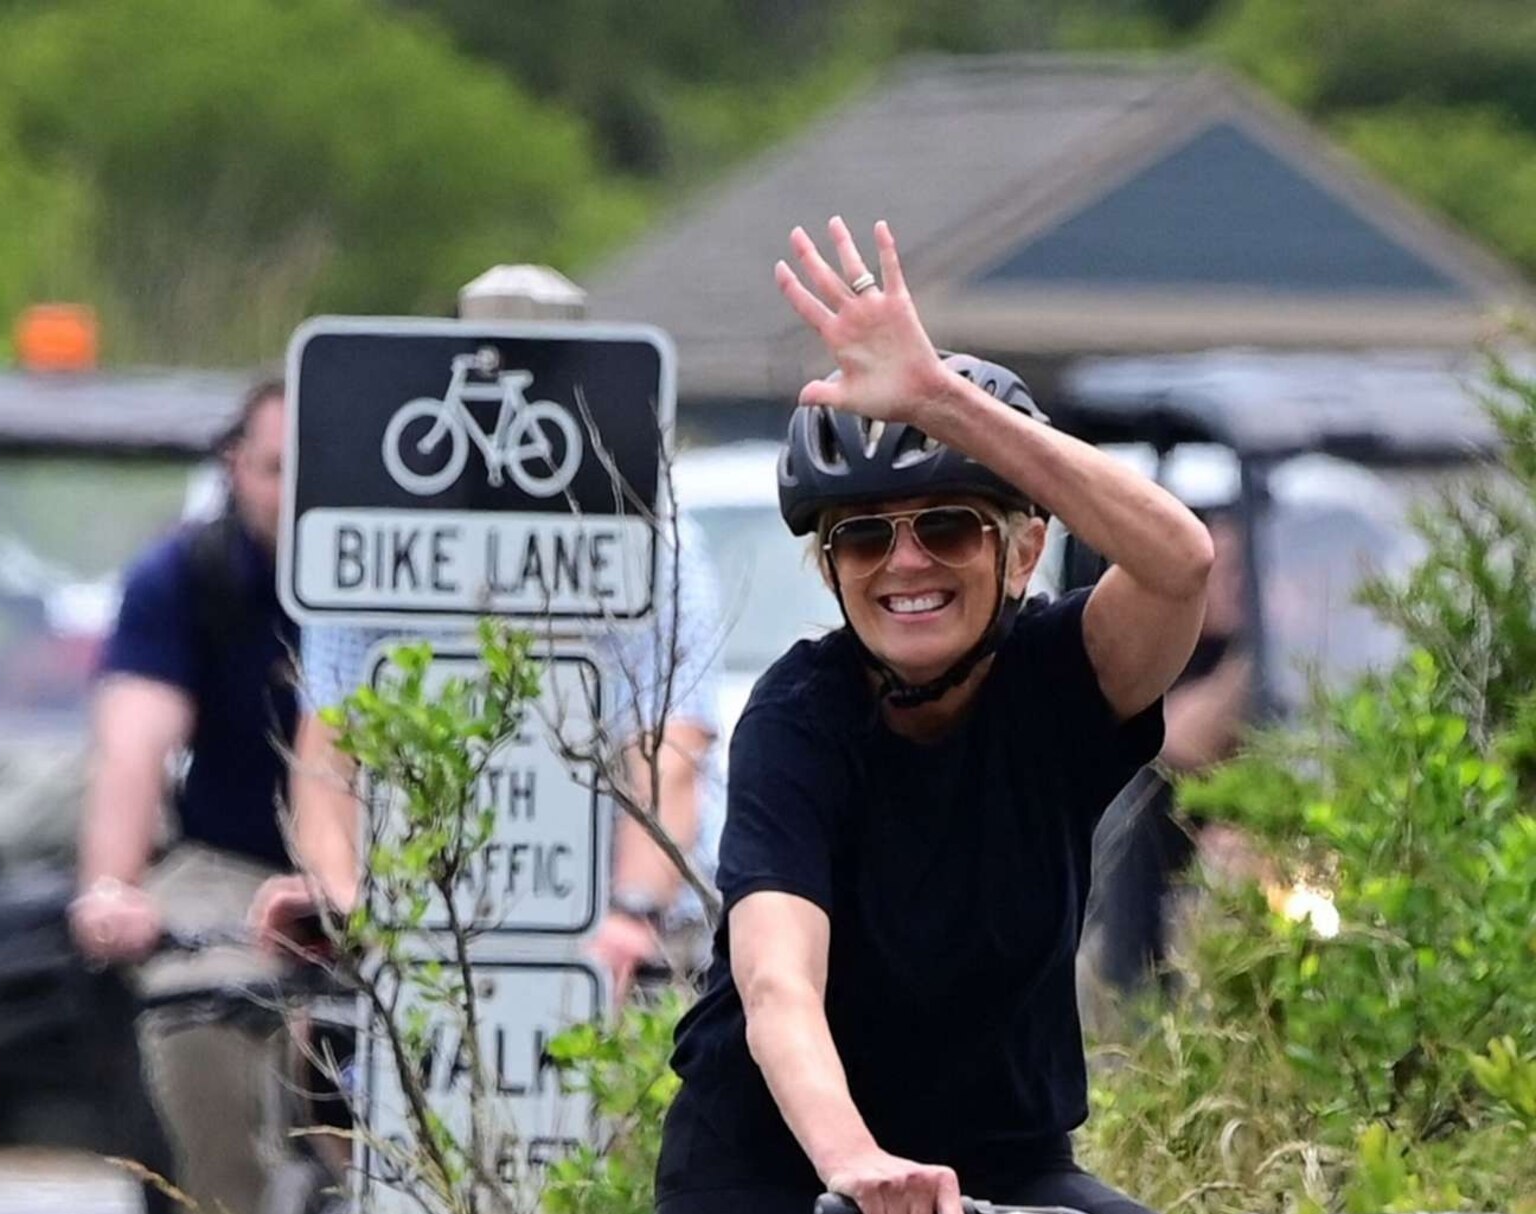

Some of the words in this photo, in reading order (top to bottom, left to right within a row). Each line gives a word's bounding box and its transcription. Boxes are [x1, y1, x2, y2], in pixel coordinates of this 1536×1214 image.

[335, 526, 460, 592] BIKE
[486, 528, 621, 598] LANE
[472, 768, 537, 823] TH
